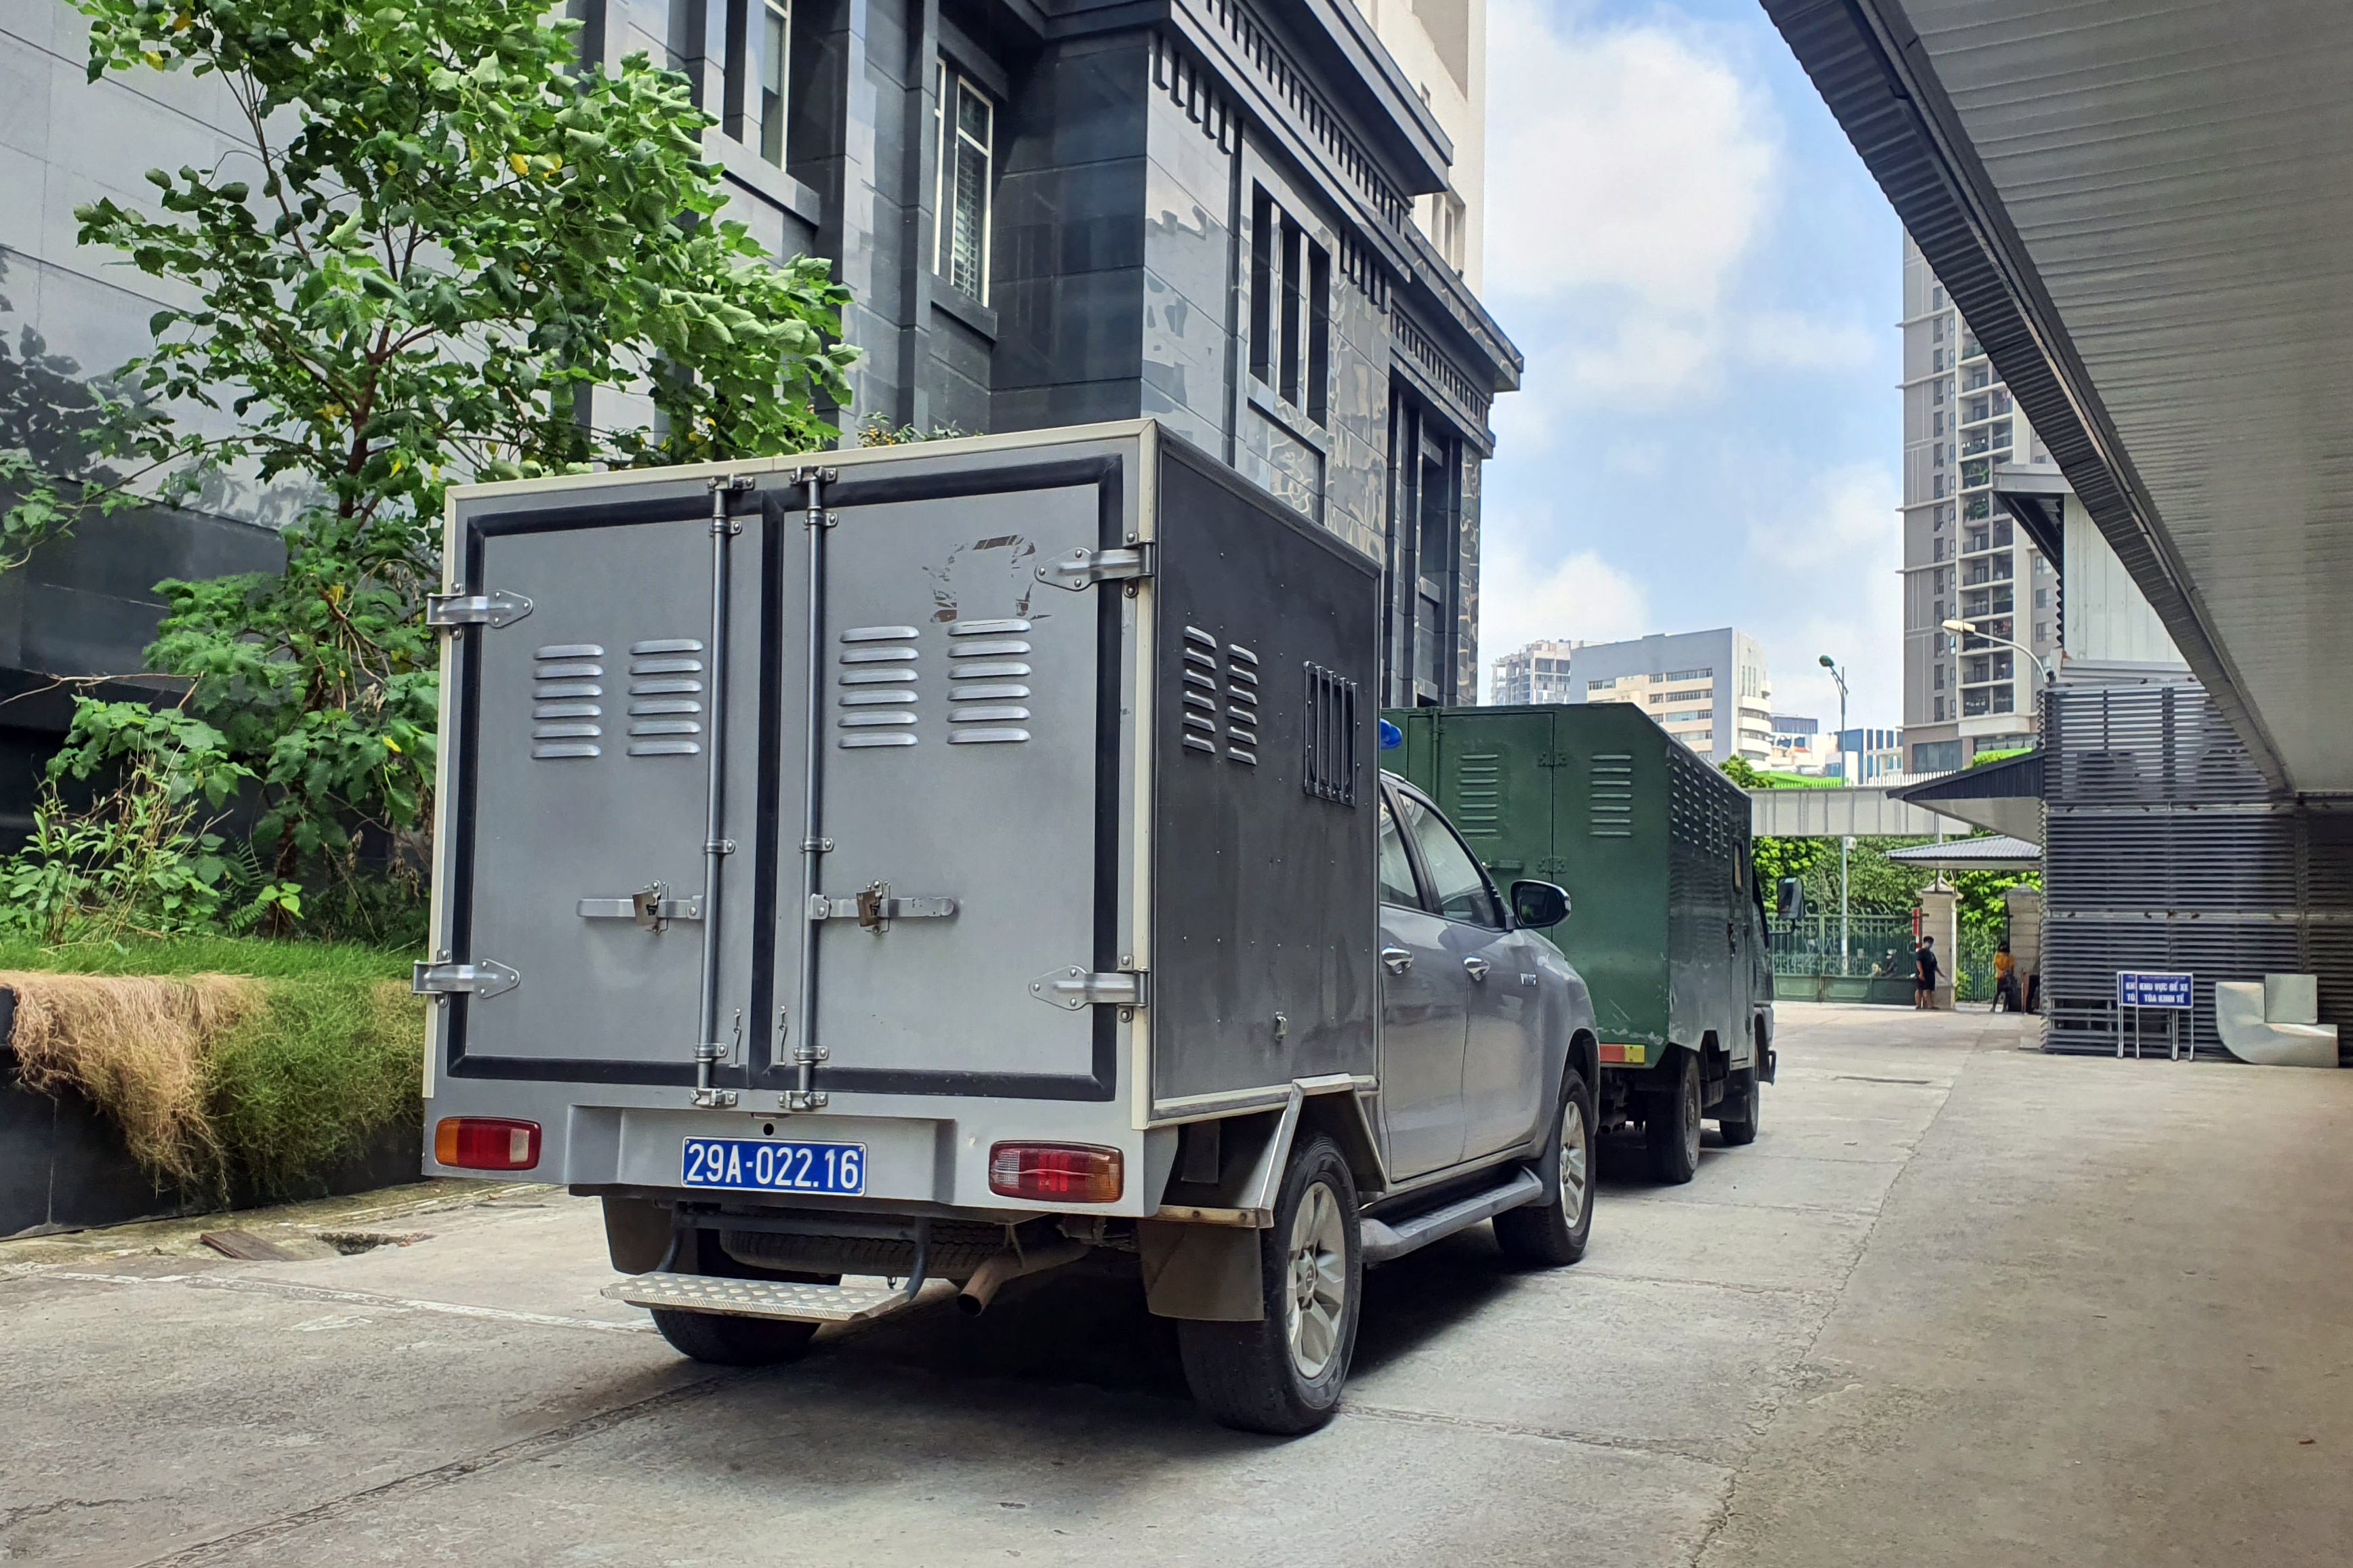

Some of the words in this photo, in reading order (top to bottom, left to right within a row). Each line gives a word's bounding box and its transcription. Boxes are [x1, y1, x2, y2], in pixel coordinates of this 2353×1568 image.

[2140, 983, 2153, 991] KHU
[2154, 983, 2167, 992] VỰC
[2180, 983, 2188, 991] XE
[2158, 995, 2175, 1003] KINH
[687, 1144, 859, 1189] 29A-022.16
